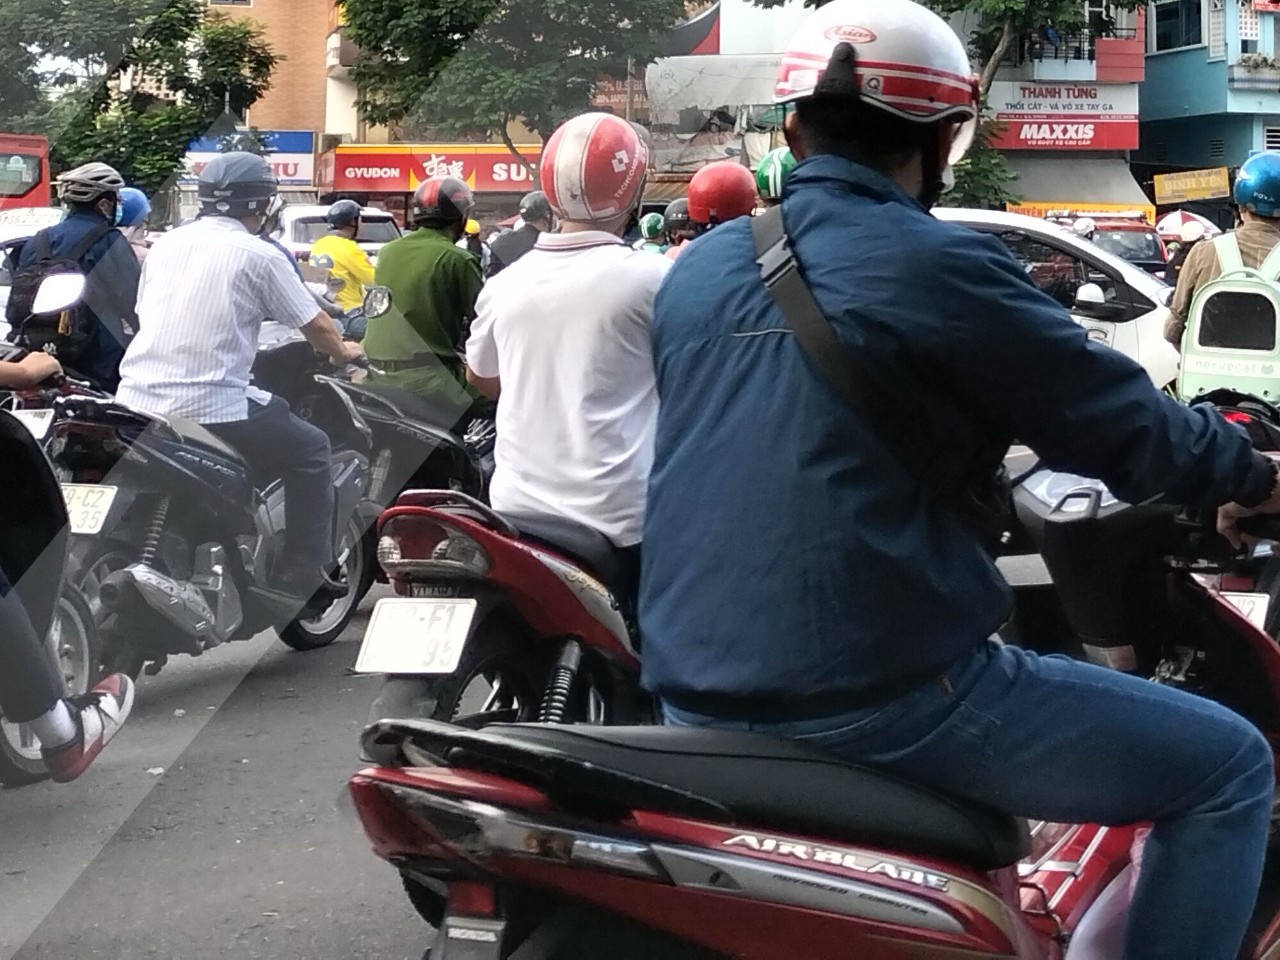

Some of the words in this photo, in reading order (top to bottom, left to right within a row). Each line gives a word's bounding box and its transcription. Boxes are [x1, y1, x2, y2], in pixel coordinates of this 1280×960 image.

[1020, 87, 1062, 99] THANH
[1065, 85, 1098, 99] TÙNG
[1101, 103, 1114, 111] GA
[1020, 124, 1095, 139] MAXXIS
[345, 167, 400, 178] GYUDON
[63, 487, 105, 508] 9-C2
[413, 586, 454, 597] YAMAHA
